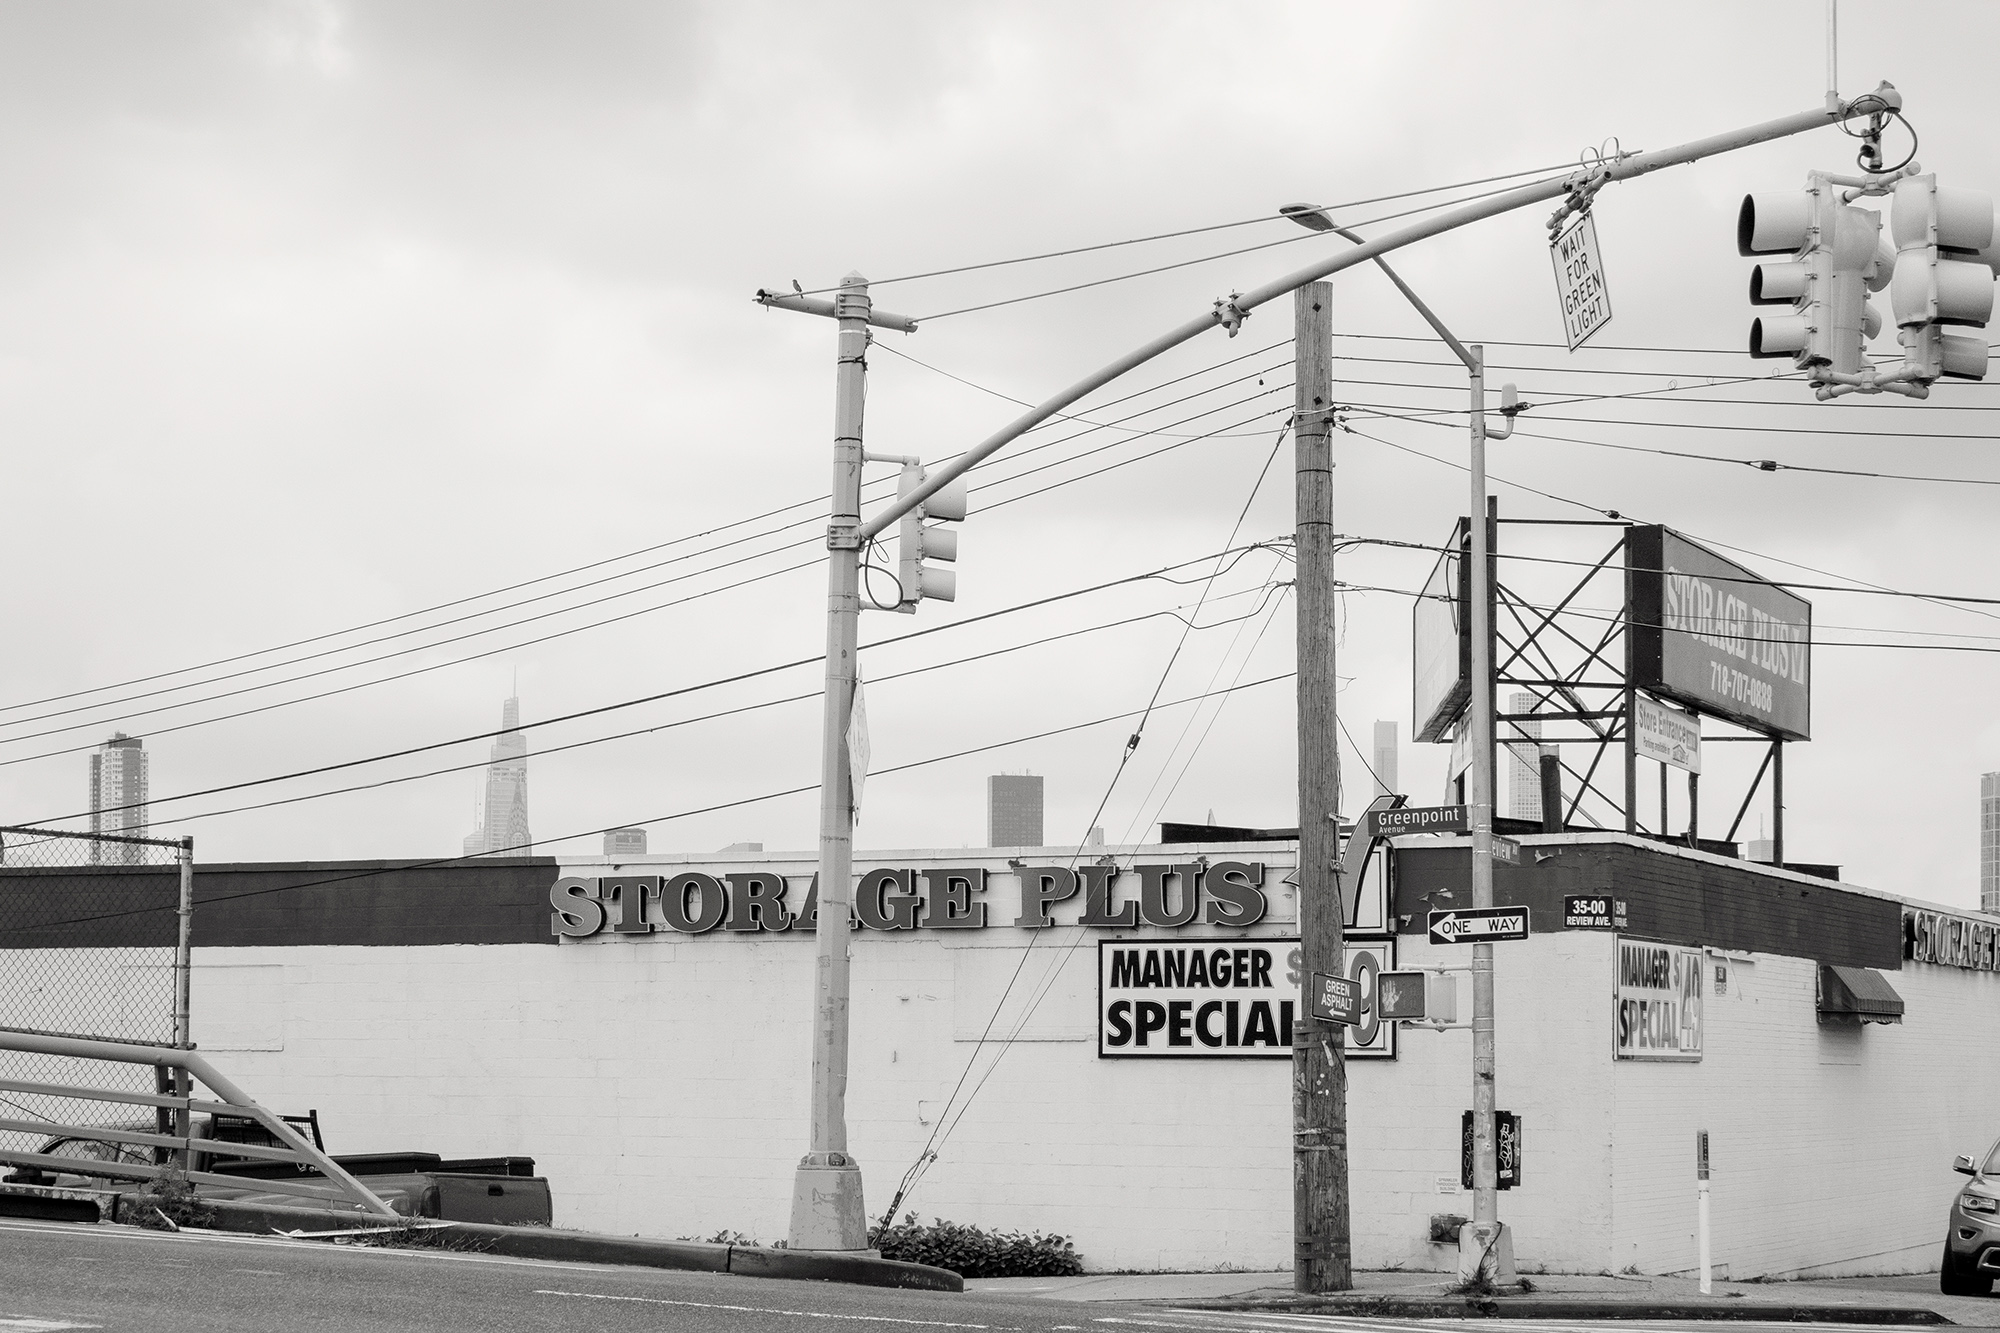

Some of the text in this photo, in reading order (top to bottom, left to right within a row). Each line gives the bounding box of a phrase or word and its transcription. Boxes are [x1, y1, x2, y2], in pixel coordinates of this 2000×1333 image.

[1560, 226, 1585, 262] WAIT
[1567, 252, 1589, 286] FOR
[1565, 270, 1601, 315] GREEN
[1571, 296, 1602, 338] LIGHT
[1666, 566, 1788, 679] STORAGE PLUS
[1710, 661, 1772, 713] 718-707-0888
[1639, 703, 1686, 743] Store Entrance
[1378, 807, 1459, 826] Greenpoint
[1378, 825, 1406, 834] Avenue
[1013, 861, 1266, 928] PLUS
[1572, 900, 1606, 914] 35-00
[1442, 917, 1519, 934] ONE WAY
[1566, 916, 1611, 926] REVIEW AVE.
[1110, 948, 1273, 988] MANAGER
[1620, 945, 1670, 990] MANAGER
[1321, 993, 1353, 1011] ASPHALT
[1325, 980, 1350, 997] GREEN
[1619, 998, 1679, 1049] SPECIAL
